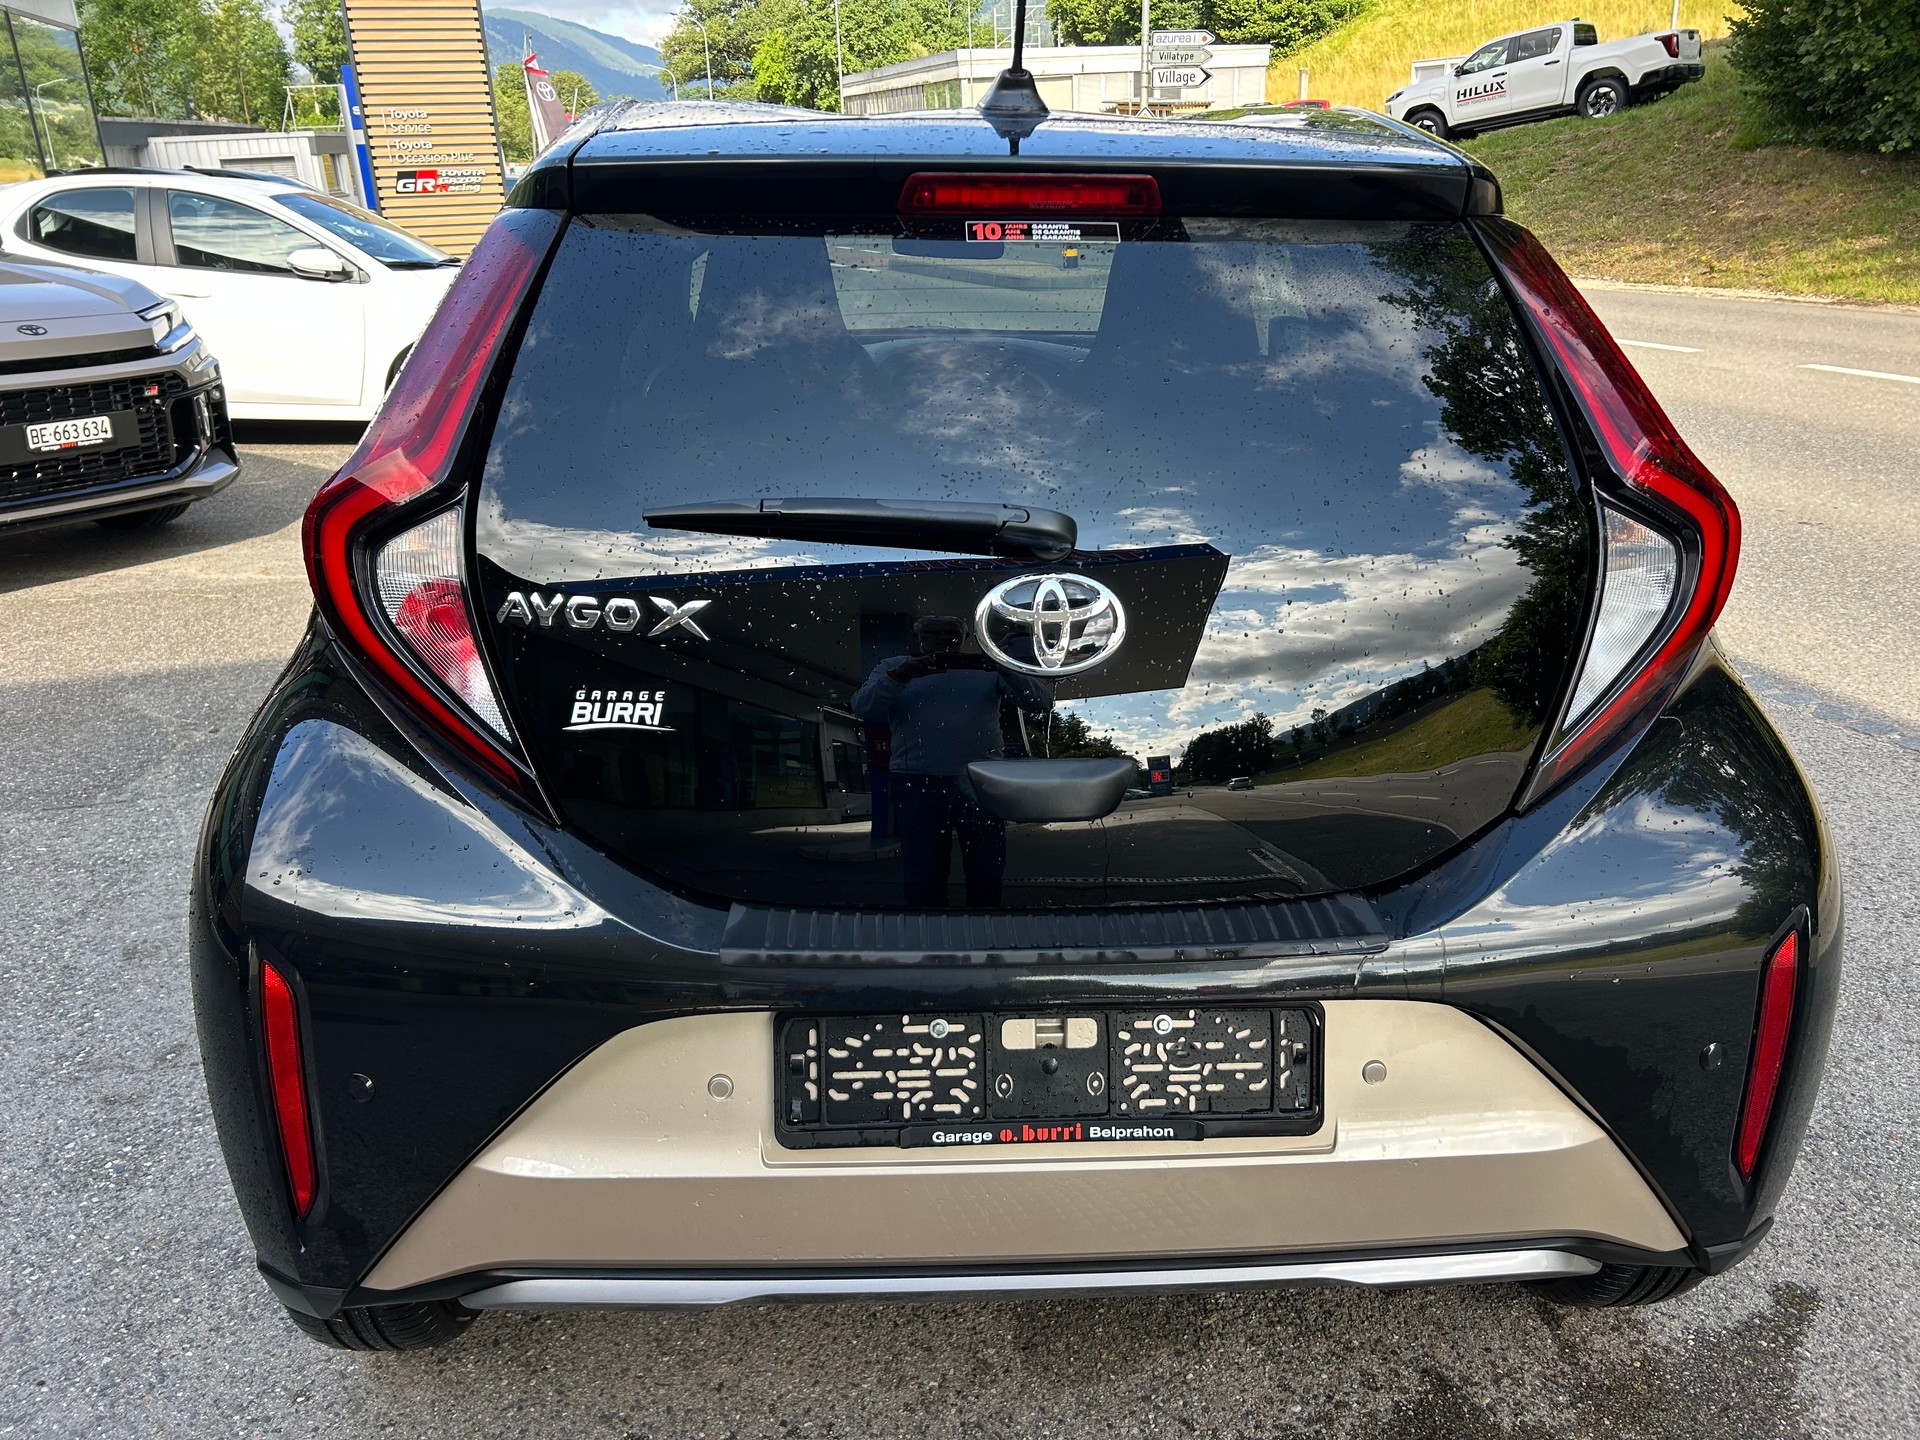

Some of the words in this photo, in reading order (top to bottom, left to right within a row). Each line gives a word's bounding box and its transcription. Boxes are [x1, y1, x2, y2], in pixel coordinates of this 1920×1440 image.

[1159, 52, 1194, 62] Villatype
[1158, 70, 1196, 86] Village
[1457, 80, 1505, 99] HILUX
[388, 108, 428, 121] Toyota
[390, 122, 432, 134] Service
[394, 139, 433, 152] Toyota
[395, 153, 449, 164] Occasion
[451, 151, 475, 163] Plus
[439, 169, 486, 177] TOYOTA
[396, 178, 437, 193] GR
[438, 183, 481, 193] Racing
[972, 223, 1002, 240] 10
[83, 420, 108, 437] 634
[496, 591, 641, 632] AYGO
[647, 596, 712, 641] X
[575, 690, 666, 701] GARAGE
[570, 701, 663, 725] BURRI
[932, 1131, 993, 1144] Garage
[1022, 1123, 1082, 1142] burri
[1089, 1125, 1174, 1139] Belprahon
